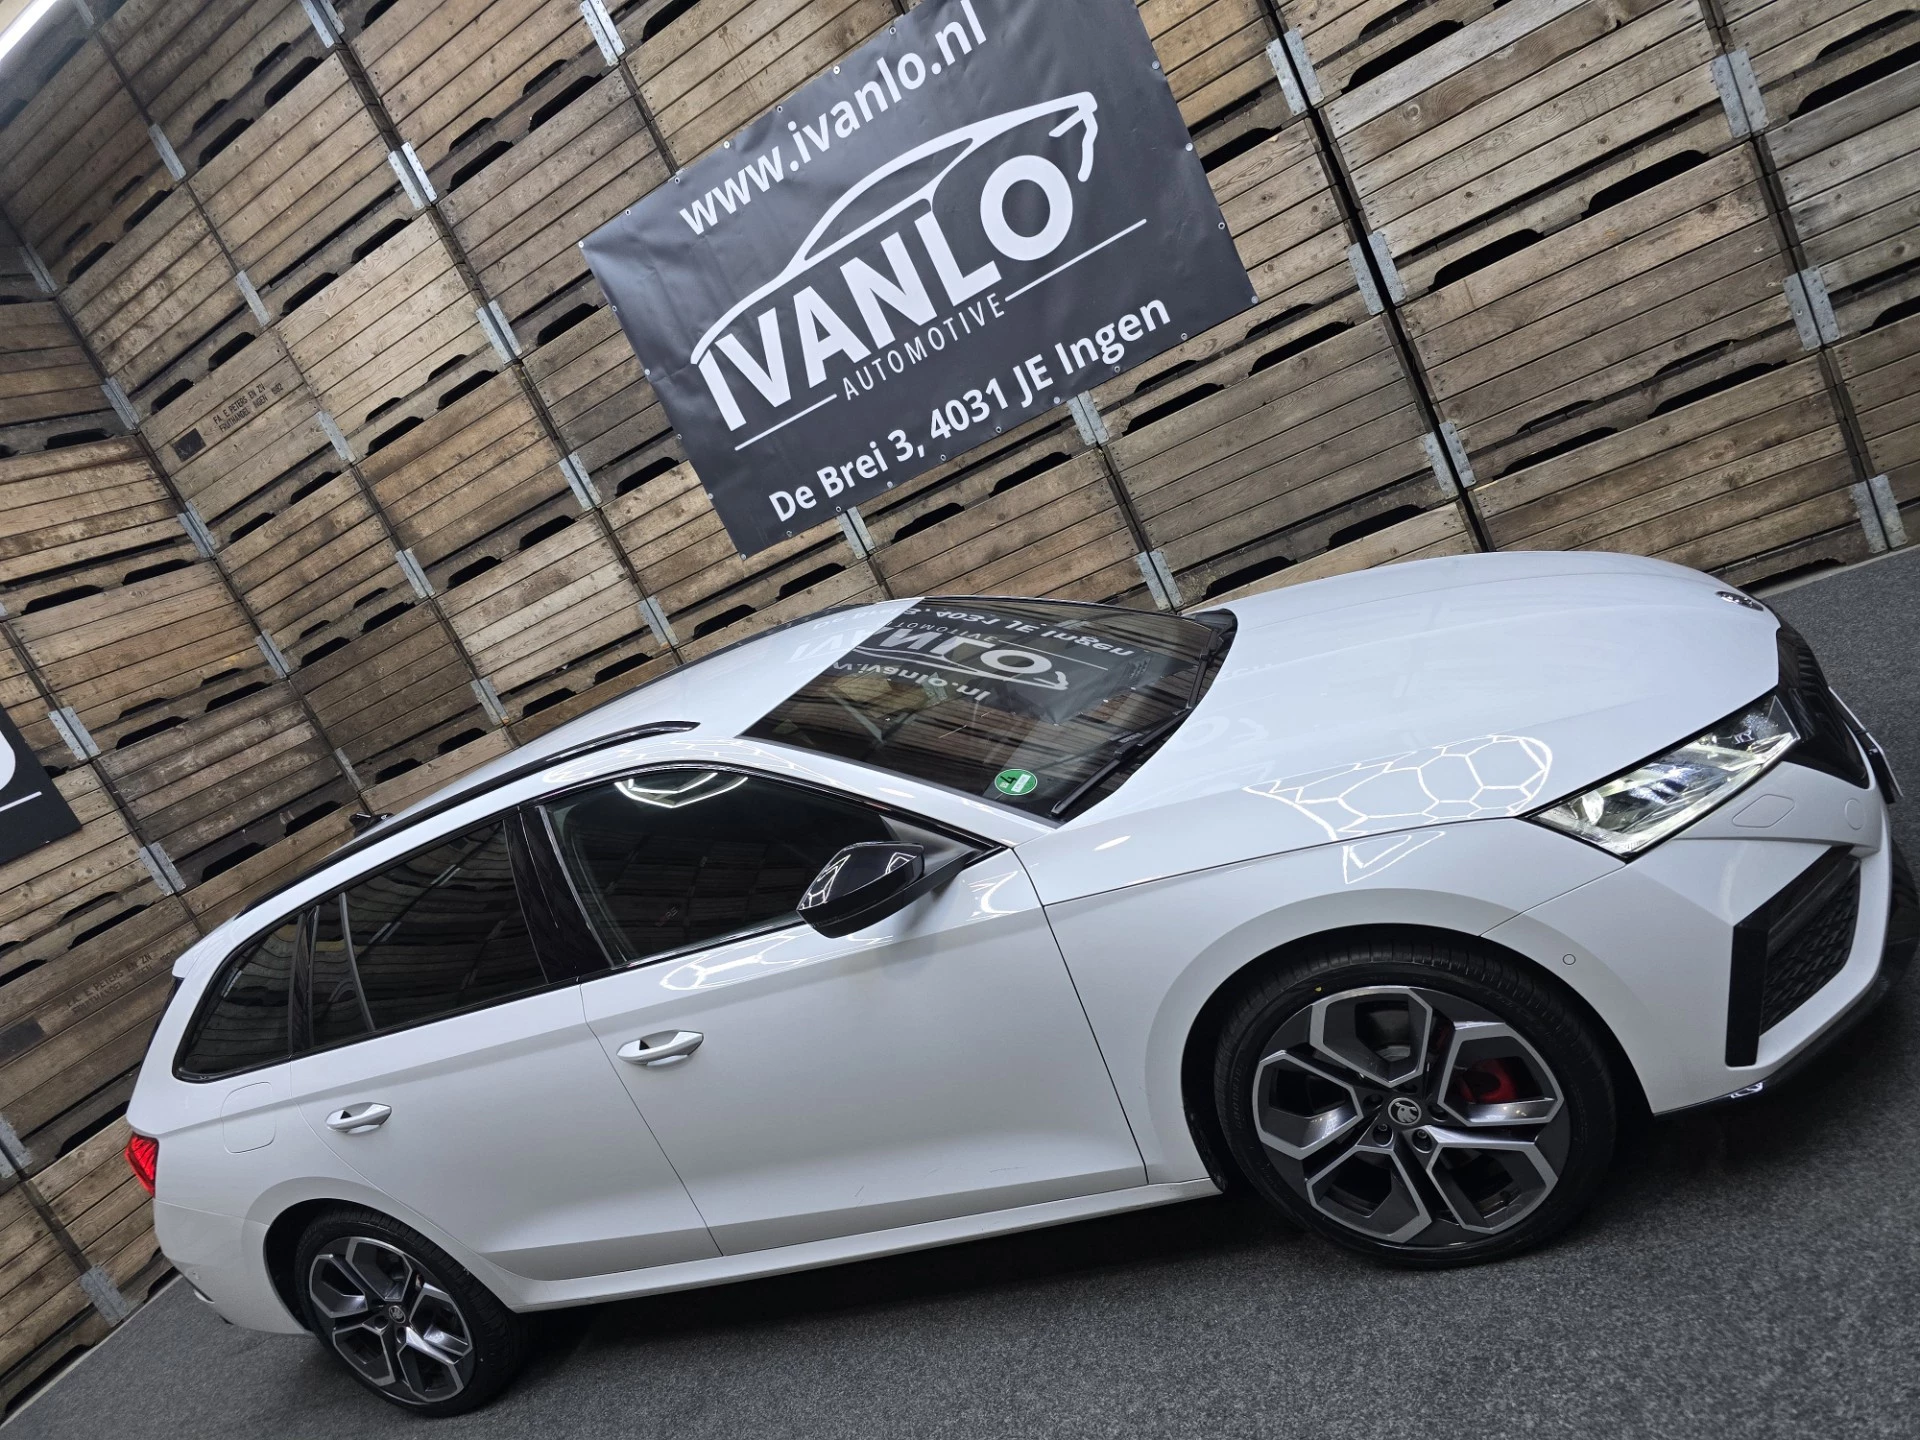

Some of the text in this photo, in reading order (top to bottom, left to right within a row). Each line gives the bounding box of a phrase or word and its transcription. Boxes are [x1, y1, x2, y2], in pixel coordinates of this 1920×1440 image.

[679, 0, 986, 235] www.ivanlo.nl
[699, 155, 1073, 431] IVANLO
[842, 292, 1004, 401] AUTOMOTIVE
[769, 299, 1171, 522] De Brei 3, 4031 JE Ingen
